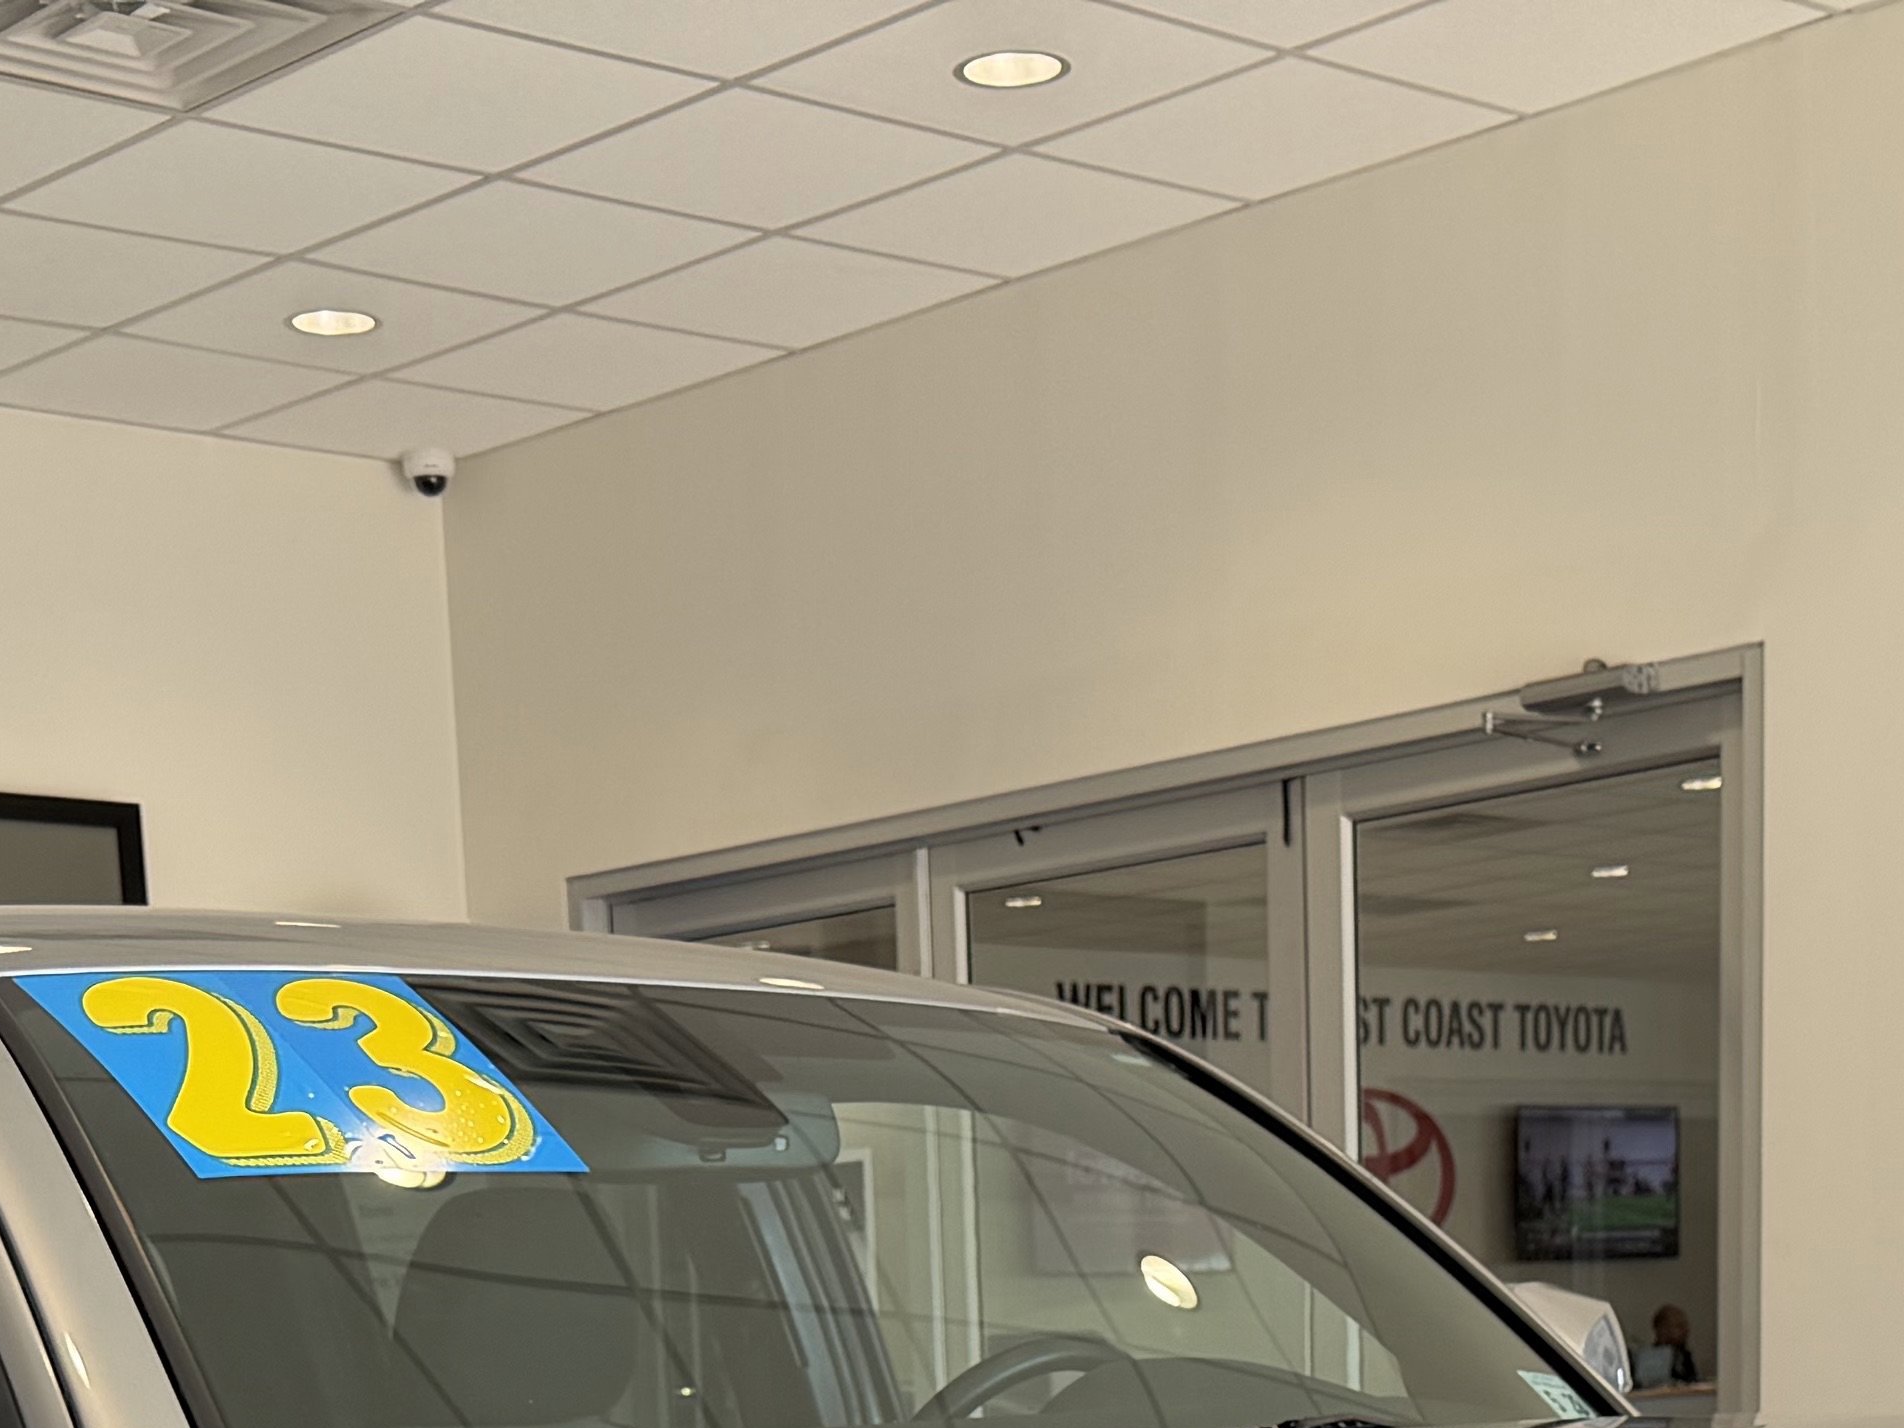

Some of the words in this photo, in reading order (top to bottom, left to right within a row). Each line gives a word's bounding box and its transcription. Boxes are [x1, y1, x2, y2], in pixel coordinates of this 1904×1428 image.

[81, 976, 537, 1167] 23
[1251, 991, 1271, 1044] T
[1356, 996, 1392, 1049] ST
[1402, 998, 1502, 1052] COAST
[1511, 1002, 1628, 1056] TOYOTA
